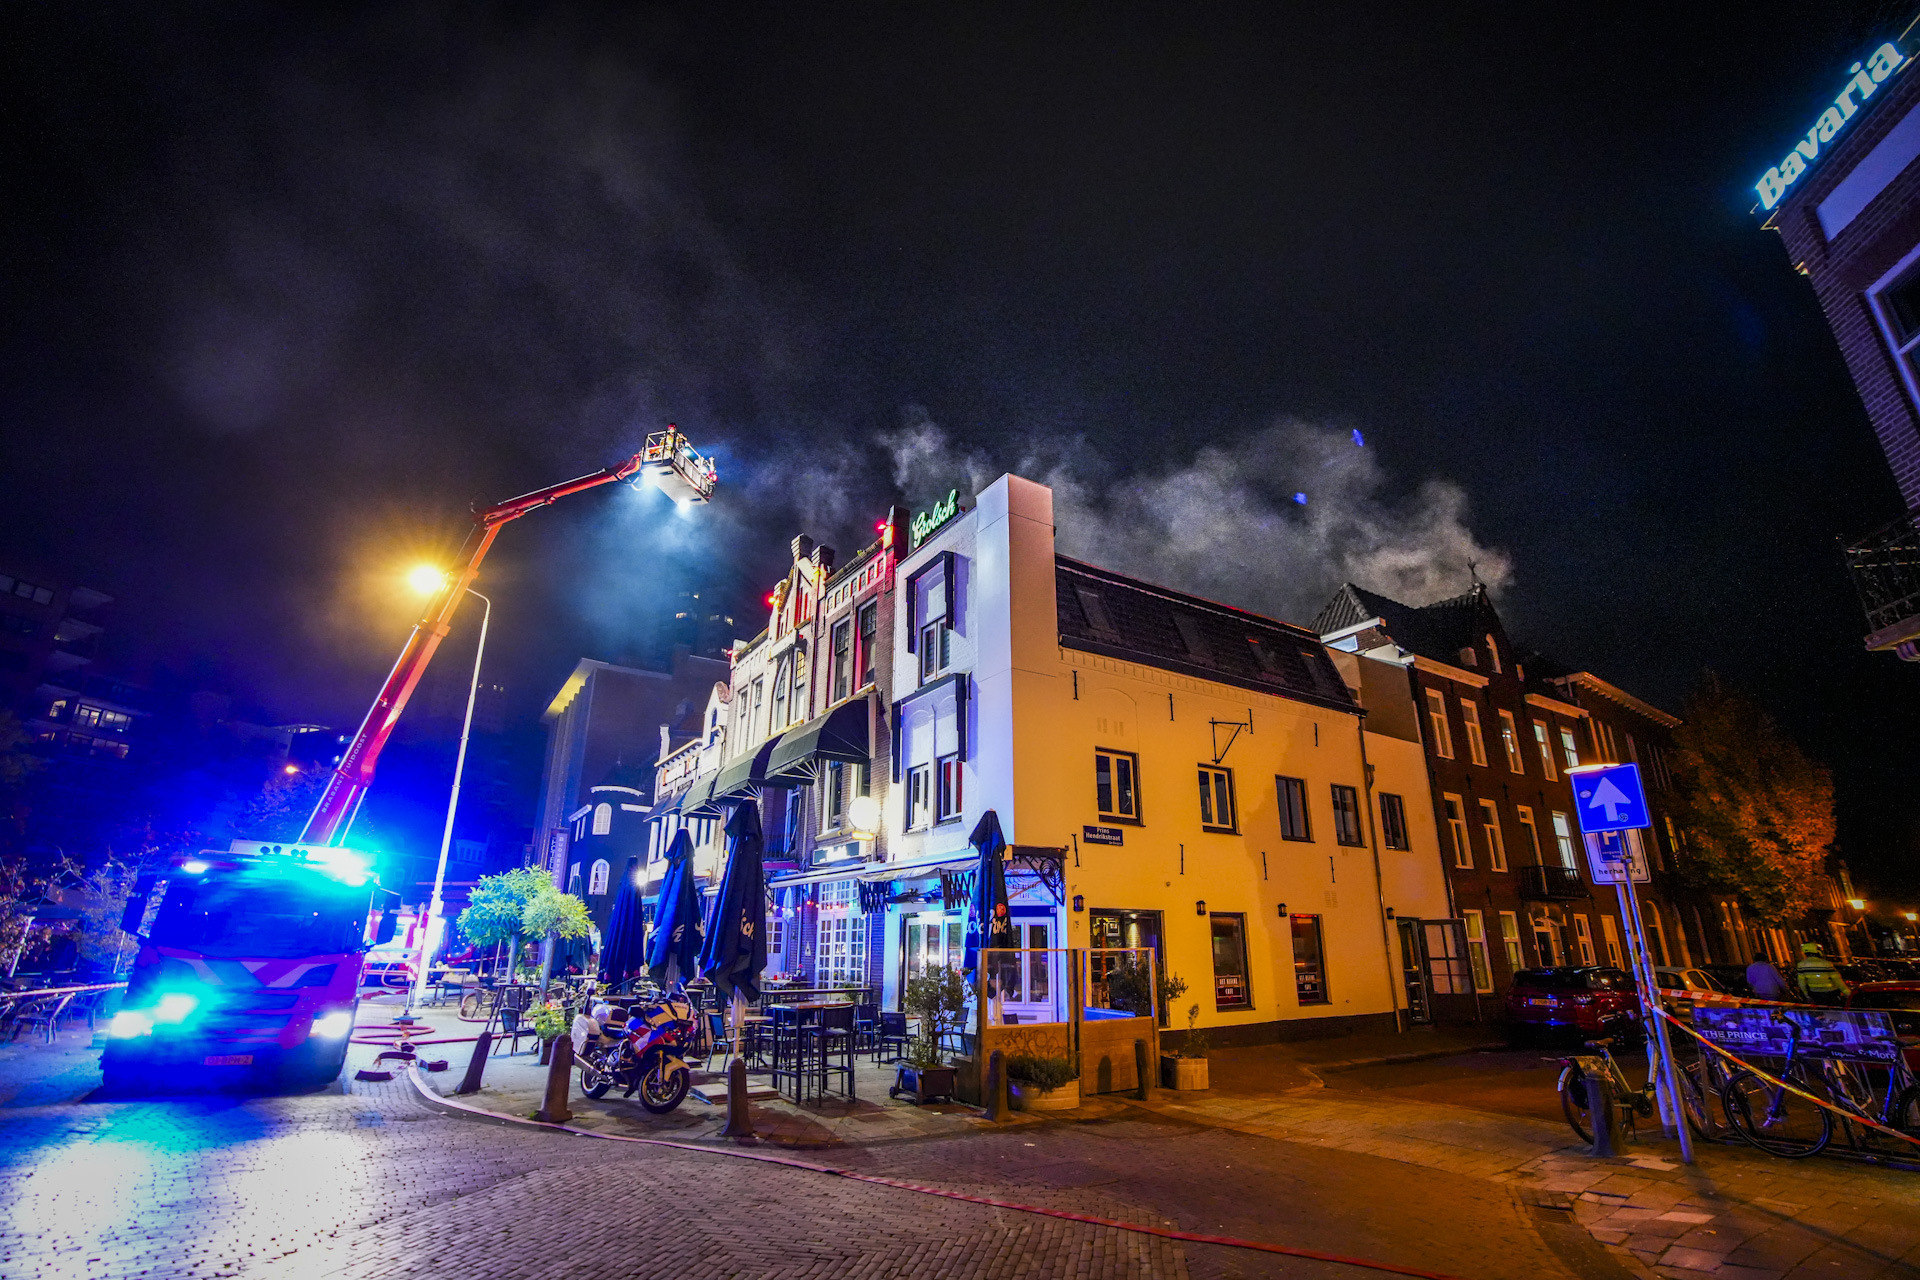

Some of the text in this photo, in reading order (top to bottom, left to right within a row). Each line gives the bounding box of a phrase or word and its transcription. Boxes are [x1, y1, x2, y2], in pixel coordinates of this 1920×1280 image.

[1755, 42, 1904, 210] Bavaria
[911, 488, 957, 549] Grolsch
[321, 774, 345, 814] BRABANT
[1085, 832, 1121, 842] Hendrikstraat
[1598, 868, 1641, 876] herhang
[1702, 1030, 1769, 1040] THE PRINCE
[1868, 1049, 1896, 1060] More
